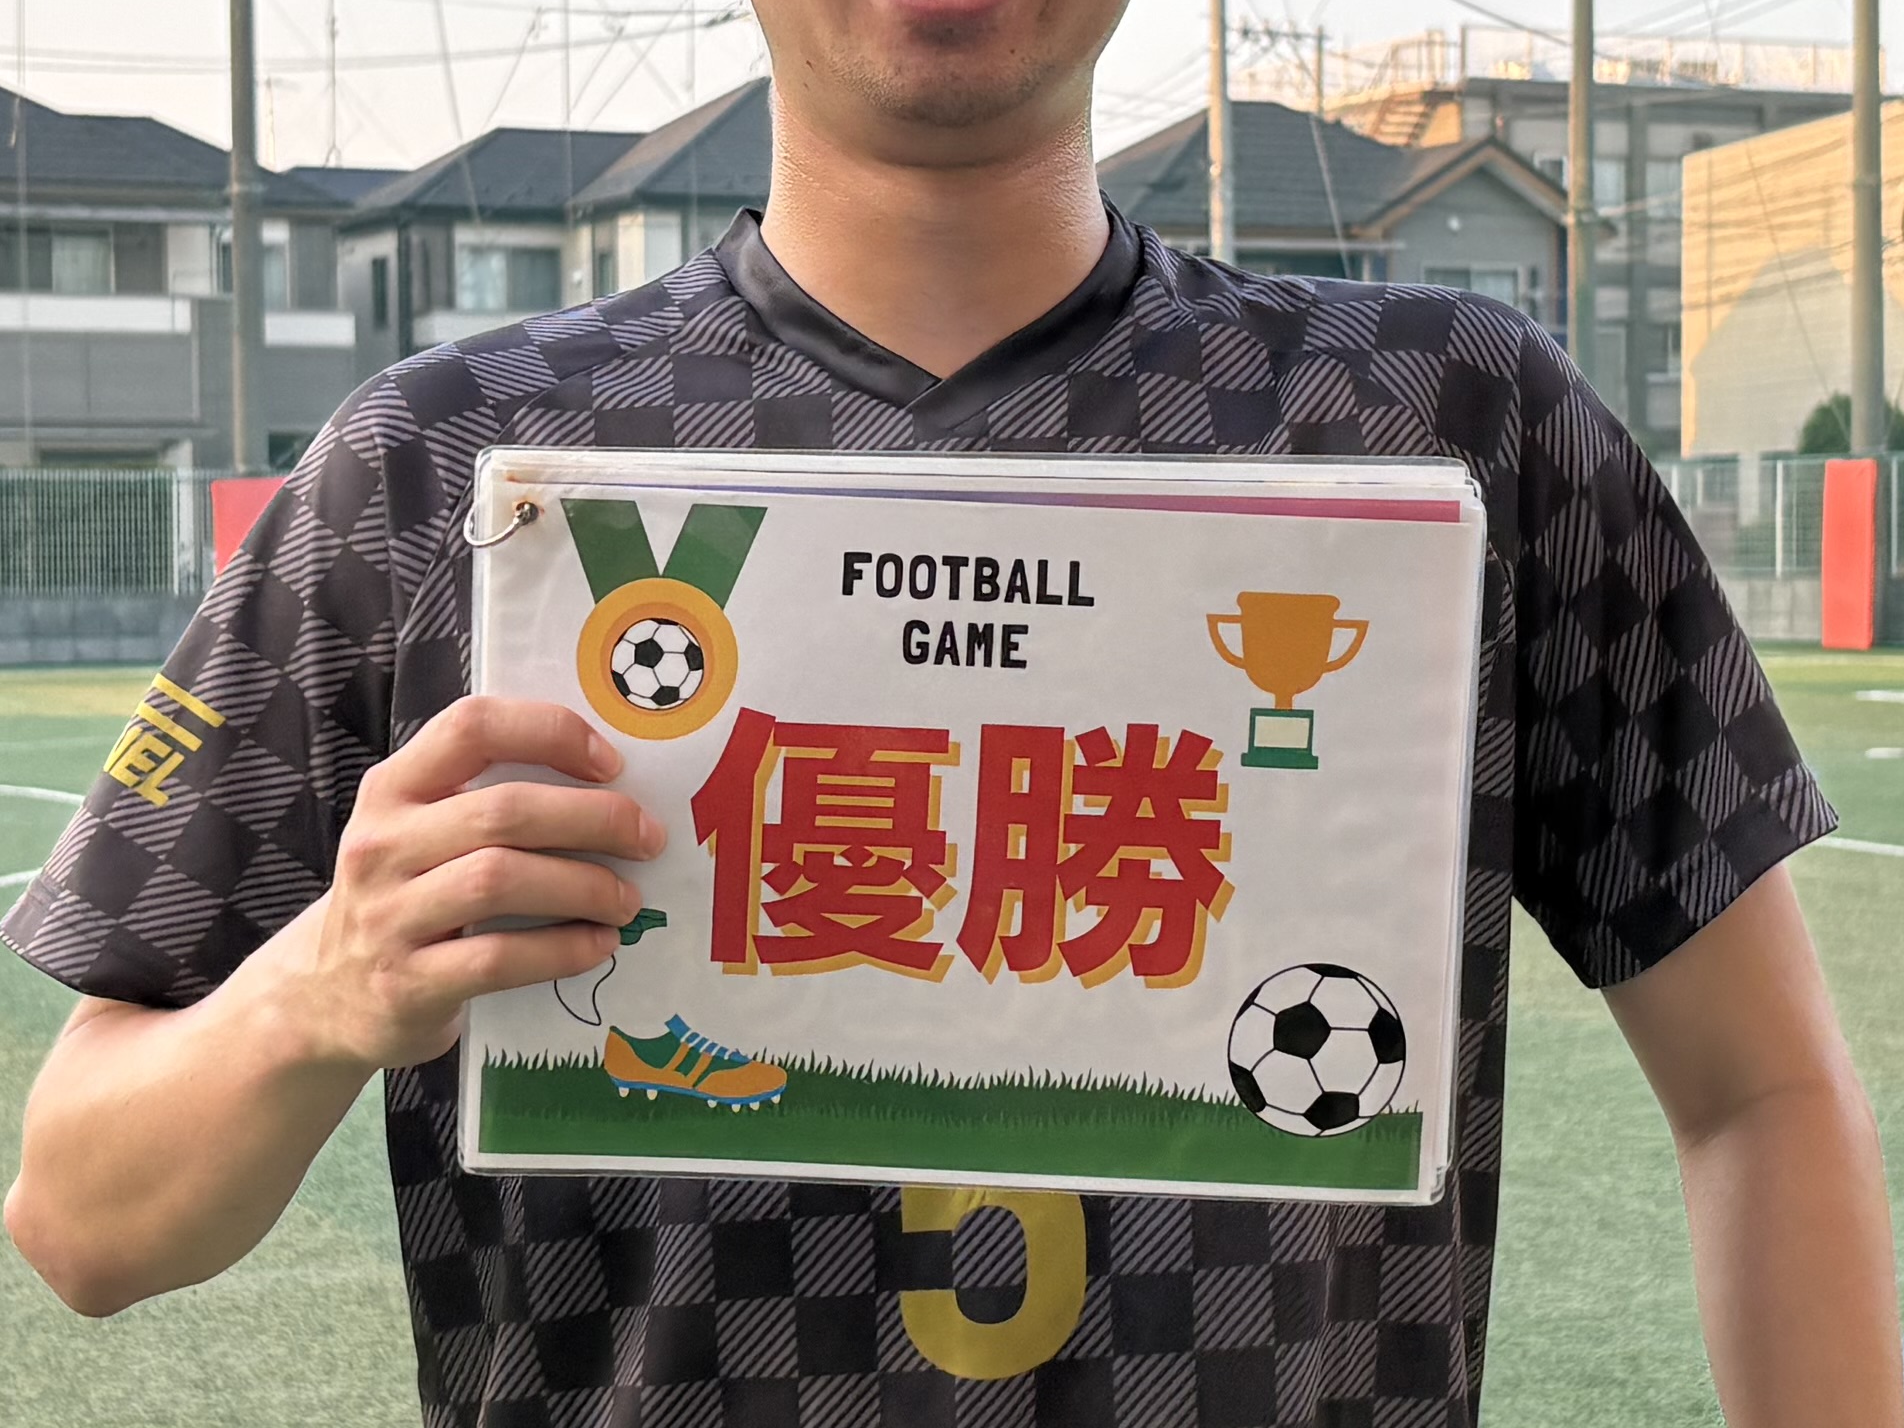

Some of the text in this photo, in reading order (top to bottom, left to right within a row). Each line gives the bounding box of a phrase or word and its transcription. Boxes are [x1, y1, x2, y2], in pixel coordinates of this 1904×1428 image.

[842, 551, 1095, 607] FOOTBALL
[902, 619, 1029, 669] GAME
[690, 706, 1235, 989] 優勝
[899, 1185, 1087, 1381] 5
